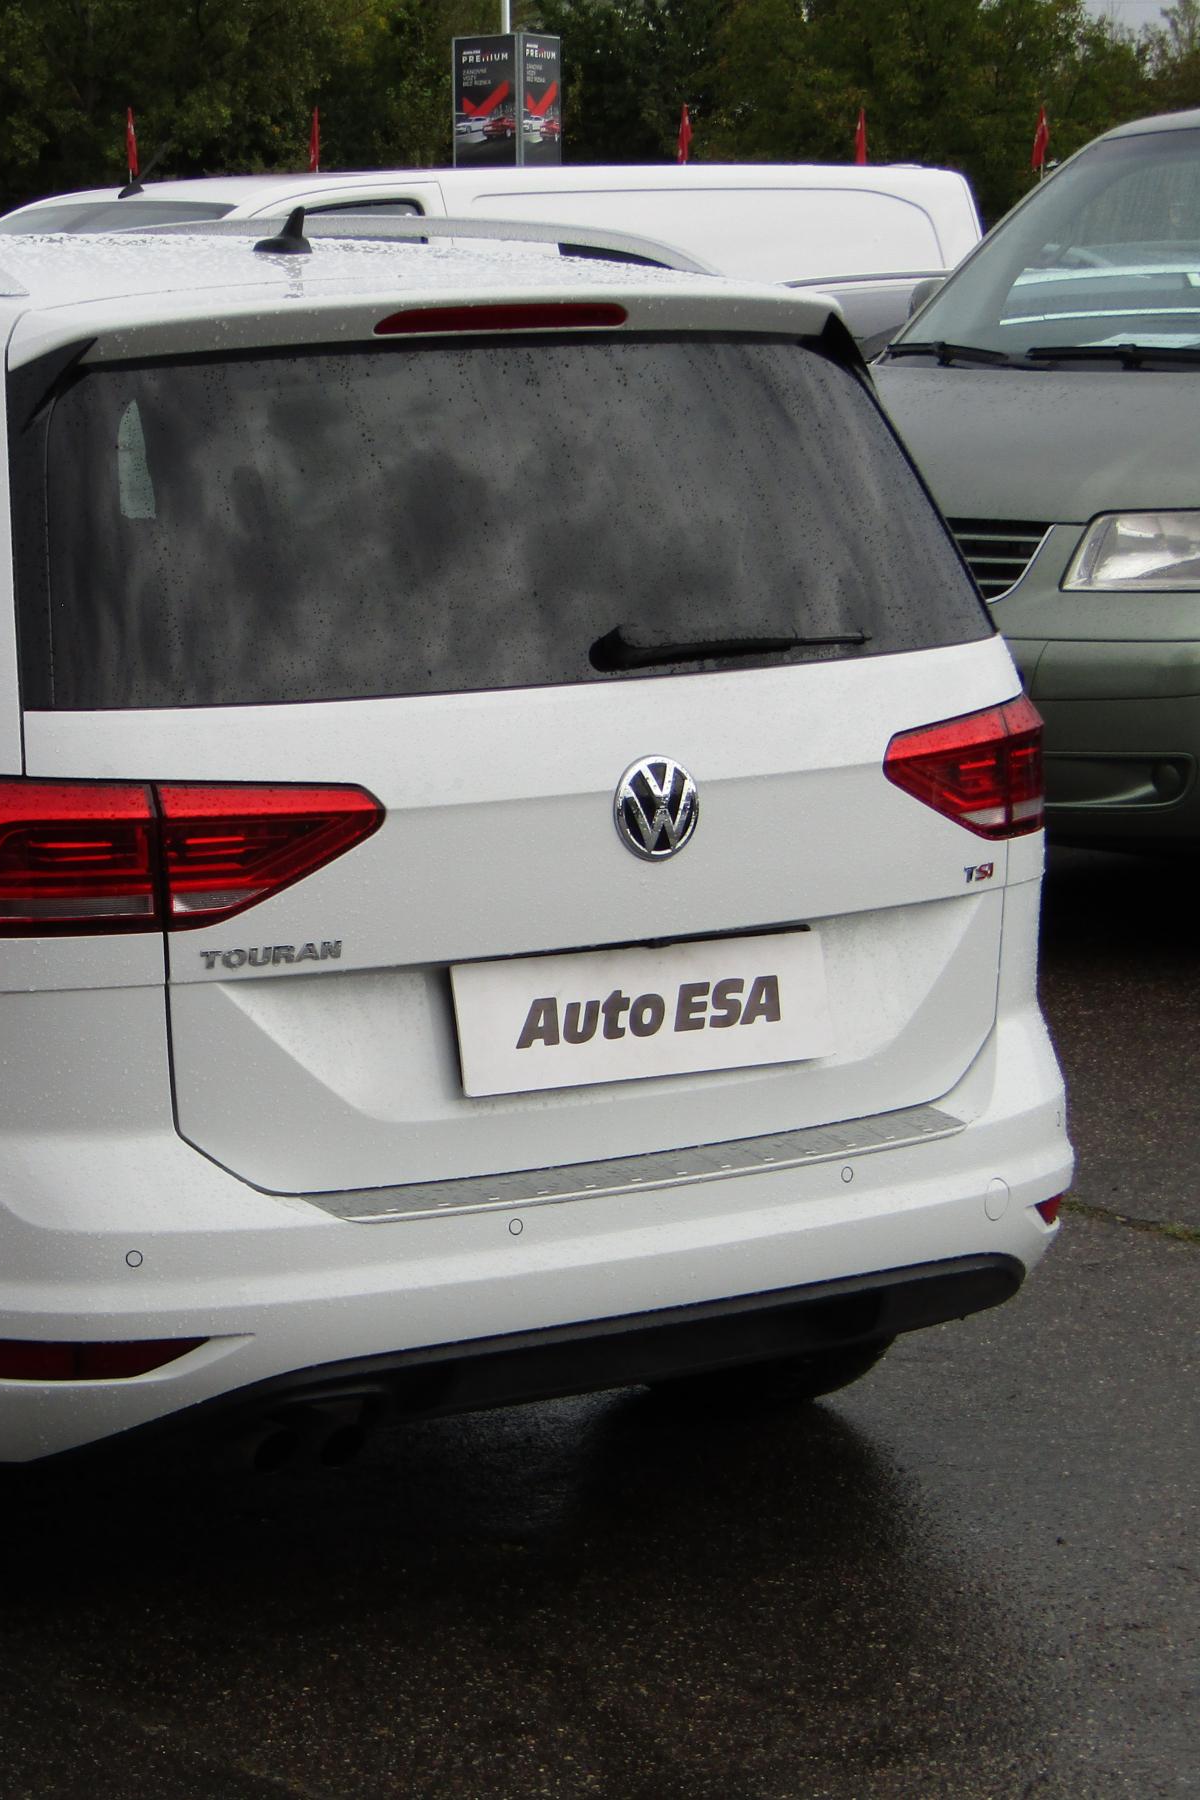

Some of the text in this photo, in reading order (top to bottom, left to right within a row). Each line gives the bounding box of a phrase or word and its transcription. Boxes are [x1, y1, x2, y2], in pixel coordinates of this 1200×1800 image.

[963, 862, 994, 883] TSI
[200, 940, 342, 971] TOURAN
[516, 975, 782, 1049] Auto ESA
